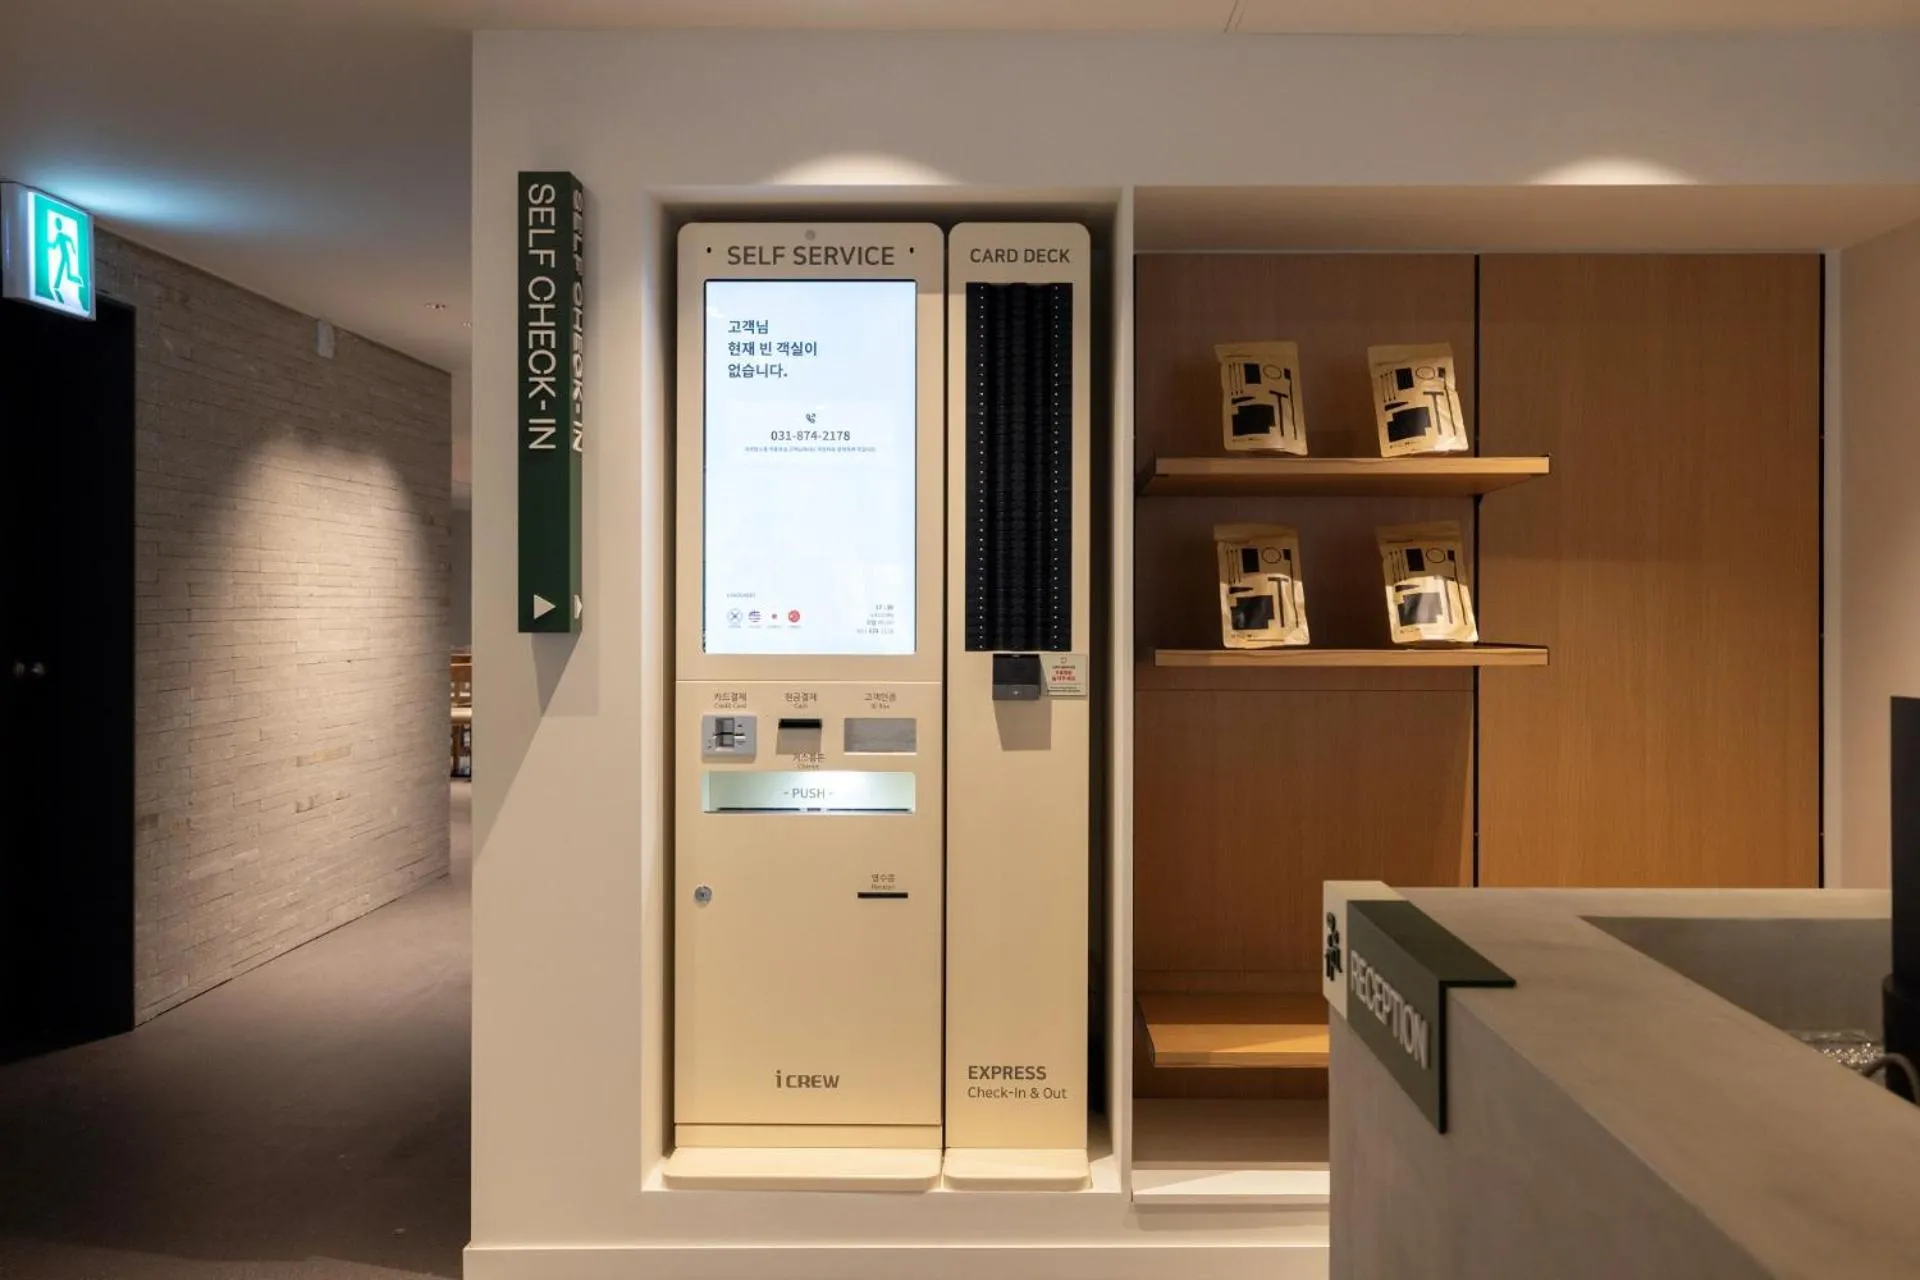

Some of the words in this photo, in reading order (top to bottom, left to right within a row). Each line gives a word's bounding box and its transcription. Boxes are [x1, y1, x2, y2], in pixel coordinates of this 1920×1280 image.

[527, 183, 556, 268] SELF
[727, 245, 786, 266] SELF
[792, 245, 895, 266] SERVICE
[970, 248, 1018, 264] CARD
[1024, 248, 1070, 264] DECK
[727, 319, 768, 335] 고객님
[727, 341, 755, 356] 현재
[760, 341, 772, 356] 빈
[777, 341, 817, 357] 객실이
[527, 276, 556, 450] CHECK-IN
[727, 363, 788, 379] 없습니다.
[771, 430, 851, 441] 031-874-2178
[792, 787, 825, 800] PUSH
[1350, 950, 1429, 1070] RECEPTION
[968, 1065, 1047, 1080] EXPRESS
[968, 1086, 1026, 1099] Check-In
[1030, 1087, 1039, 1099] &
[1043, 1087, 1067, 1099] Out
